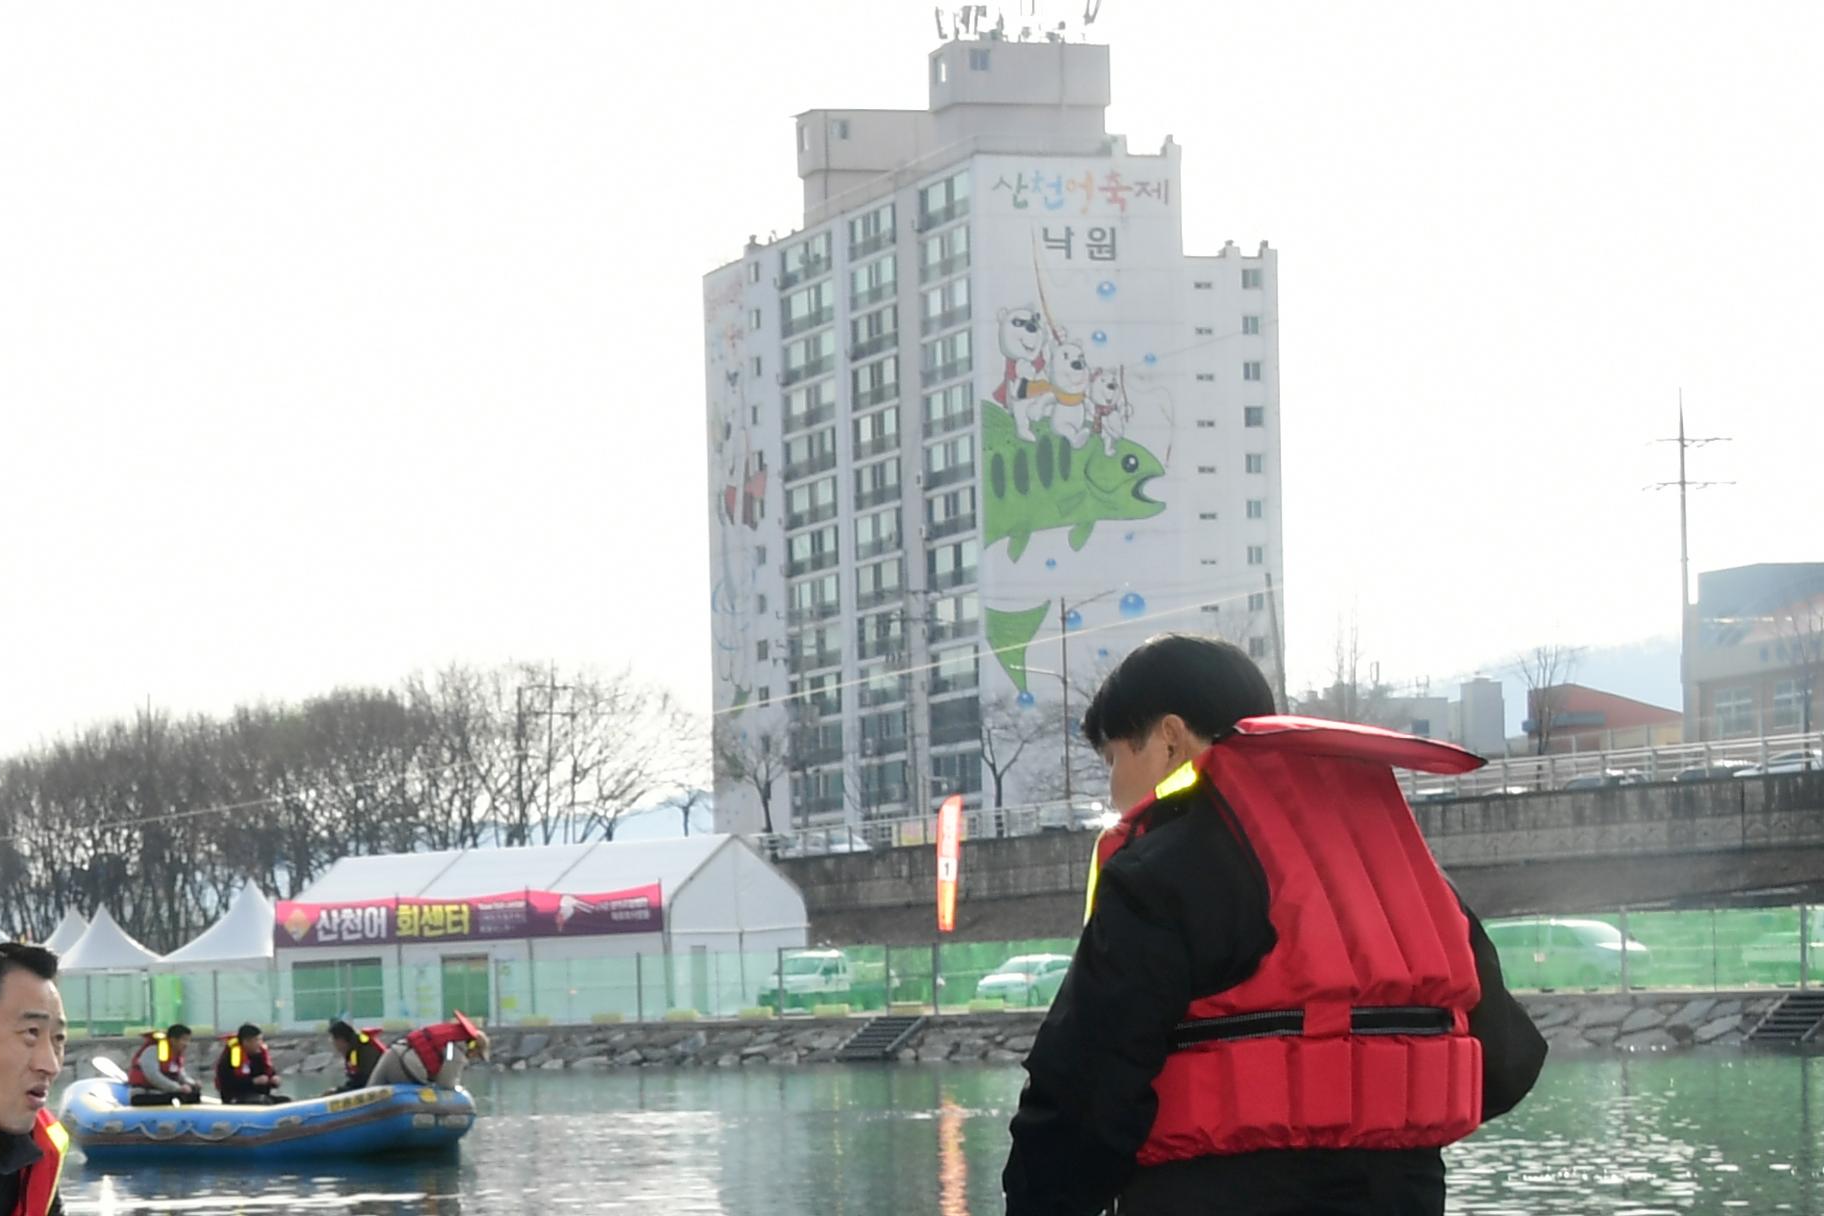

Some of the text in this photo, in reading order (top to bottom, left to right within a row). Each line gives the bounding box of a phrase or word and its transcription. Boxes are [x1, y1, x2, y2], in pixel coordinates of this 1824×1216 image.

[991, 169, 1169, 215] 산천어축제
[1042, 226, 1117, 261] 낙원
[316, 906, 387, 943] 산천어
[396, 903, 471, 938] 회센터
